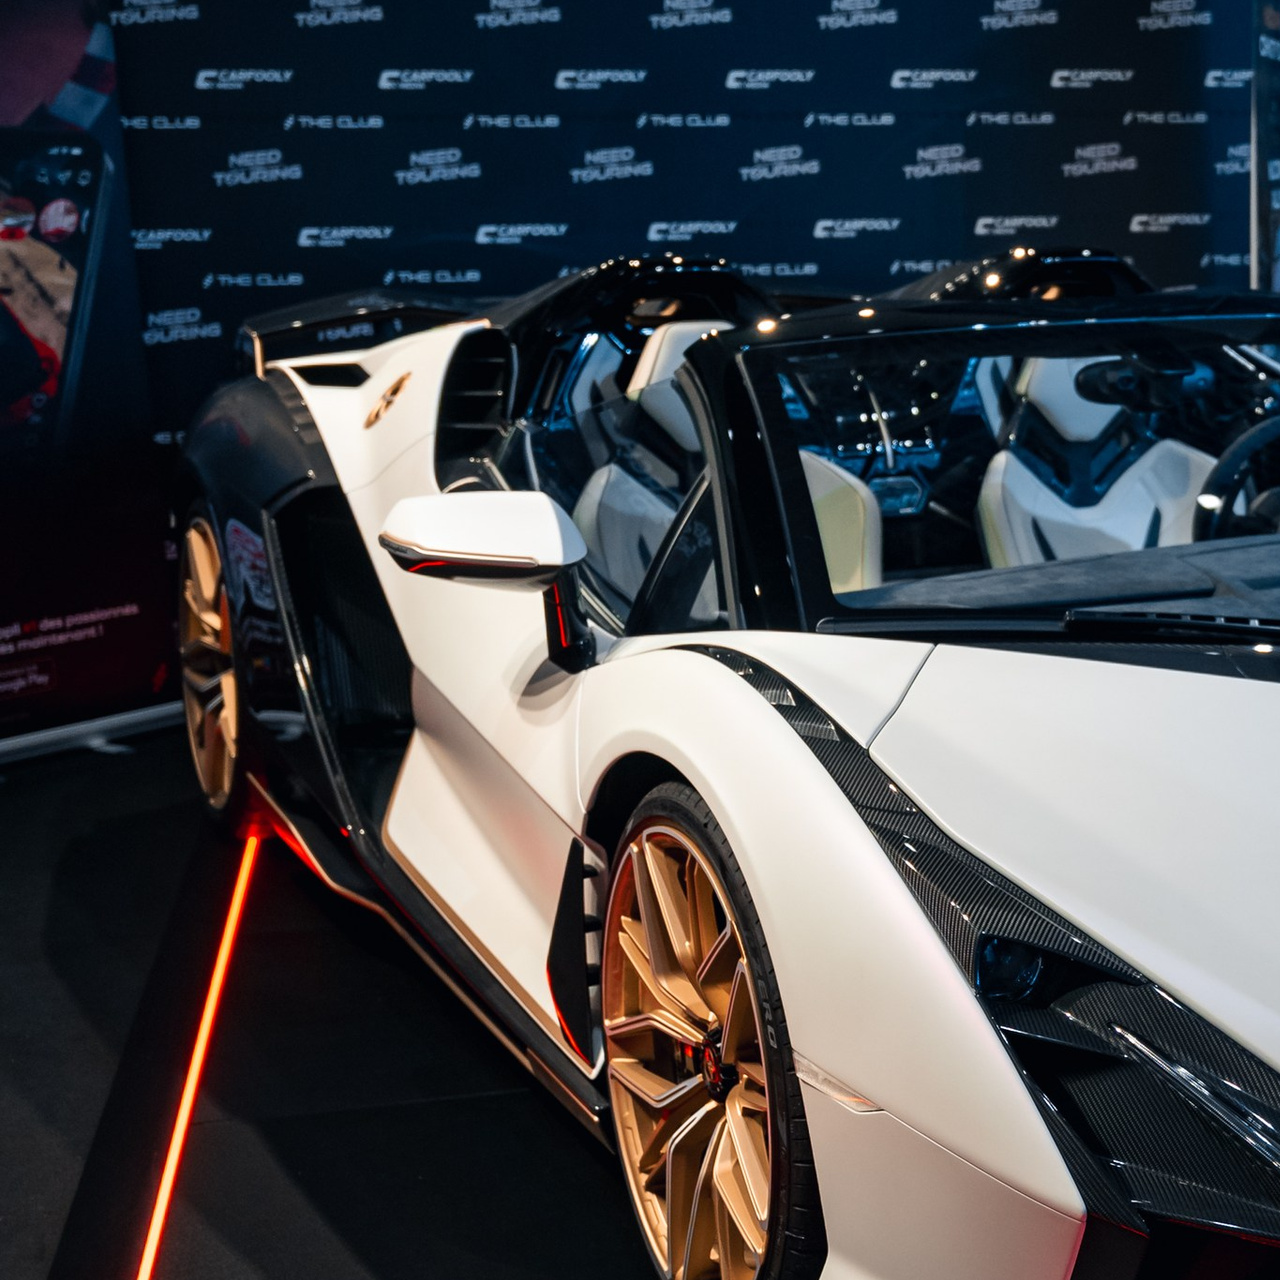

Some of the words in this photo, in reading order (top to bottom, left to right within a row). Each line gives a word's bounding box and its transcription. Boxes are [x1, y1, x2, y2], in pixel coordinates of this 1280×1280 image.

[110, 4, 200, 25] TOURING
[294, 6, 384, 27] TOURING
[474, 7, 561, 29] TOURING
[648, 8, 732, 29] TOURING
[817, 9, 898, 30] TOURING
[980, 10, 1058, 30] TOURING
[216, 69, 293, 82] CARFOOLY
[399, 69, 474, 82] CARFOOLY
[575, 69, 648, 83] CARFOOLY
[745, 69, 815, 82] CARFOOLY
[910, 69, 978, 82] CARFOOLY
[1069, 69, 1134, 81] CARFOOLY
[151, 116, 201, 129] CLUB
[298, 115, 332, 129] THE
[336, 115, 384, 129] CLUB
[478, 115, 511, 128] THE
[514, 114, 561, 128] CLUB
[650, 114, 683, 127] THE
[686, 114, 731, 127] CLUB
[818, 113, 849, 126] THE
[852, 113, 895, 126] CLUB
[980, 112, 1010, 125] THE
[1013, 112, 1055, 125] CLUB
[1136, 112, 1165, 123] THE
[1168, 112, 1208, 123] CLUB
[228, 149, 283, 168] NEED
[409, 148, 461, 166] NEED
[584, 147, 635, 164] NEED
[753, 146, 803, 163] NEED
[916, 145, 964, 162] NEED
[212, 165, 303, 187] TOURING
[394, 163, 481, 185] TOURING
[569, 162, 654, 183] TOURING
[739, 160, 821, 181] TOURING
[902, 159, 982, 179] TOURING
[318, 226, 394, 239] CARFOOLY
[495, 223, 568, 236] CARFOOLY
[667, 221, 738, 234] CARFOOLY
[136, 228, 212, 242] CARFOOLY
[904, 260, 934, 273] THE
[1212, 254, 1241, 266] THE
[398, 270, 431, 283] THE
[434, 269, 481, 283] CLUB
[740, 264, 770, 276] THE
[774, 263, 818, 276] CLUB
[218, 274, 252, 287] THE
[256, 272, 304, 286] CLUB
[147, 307, 201, 327] NEED
[142, 322, 222, 346] OURING
